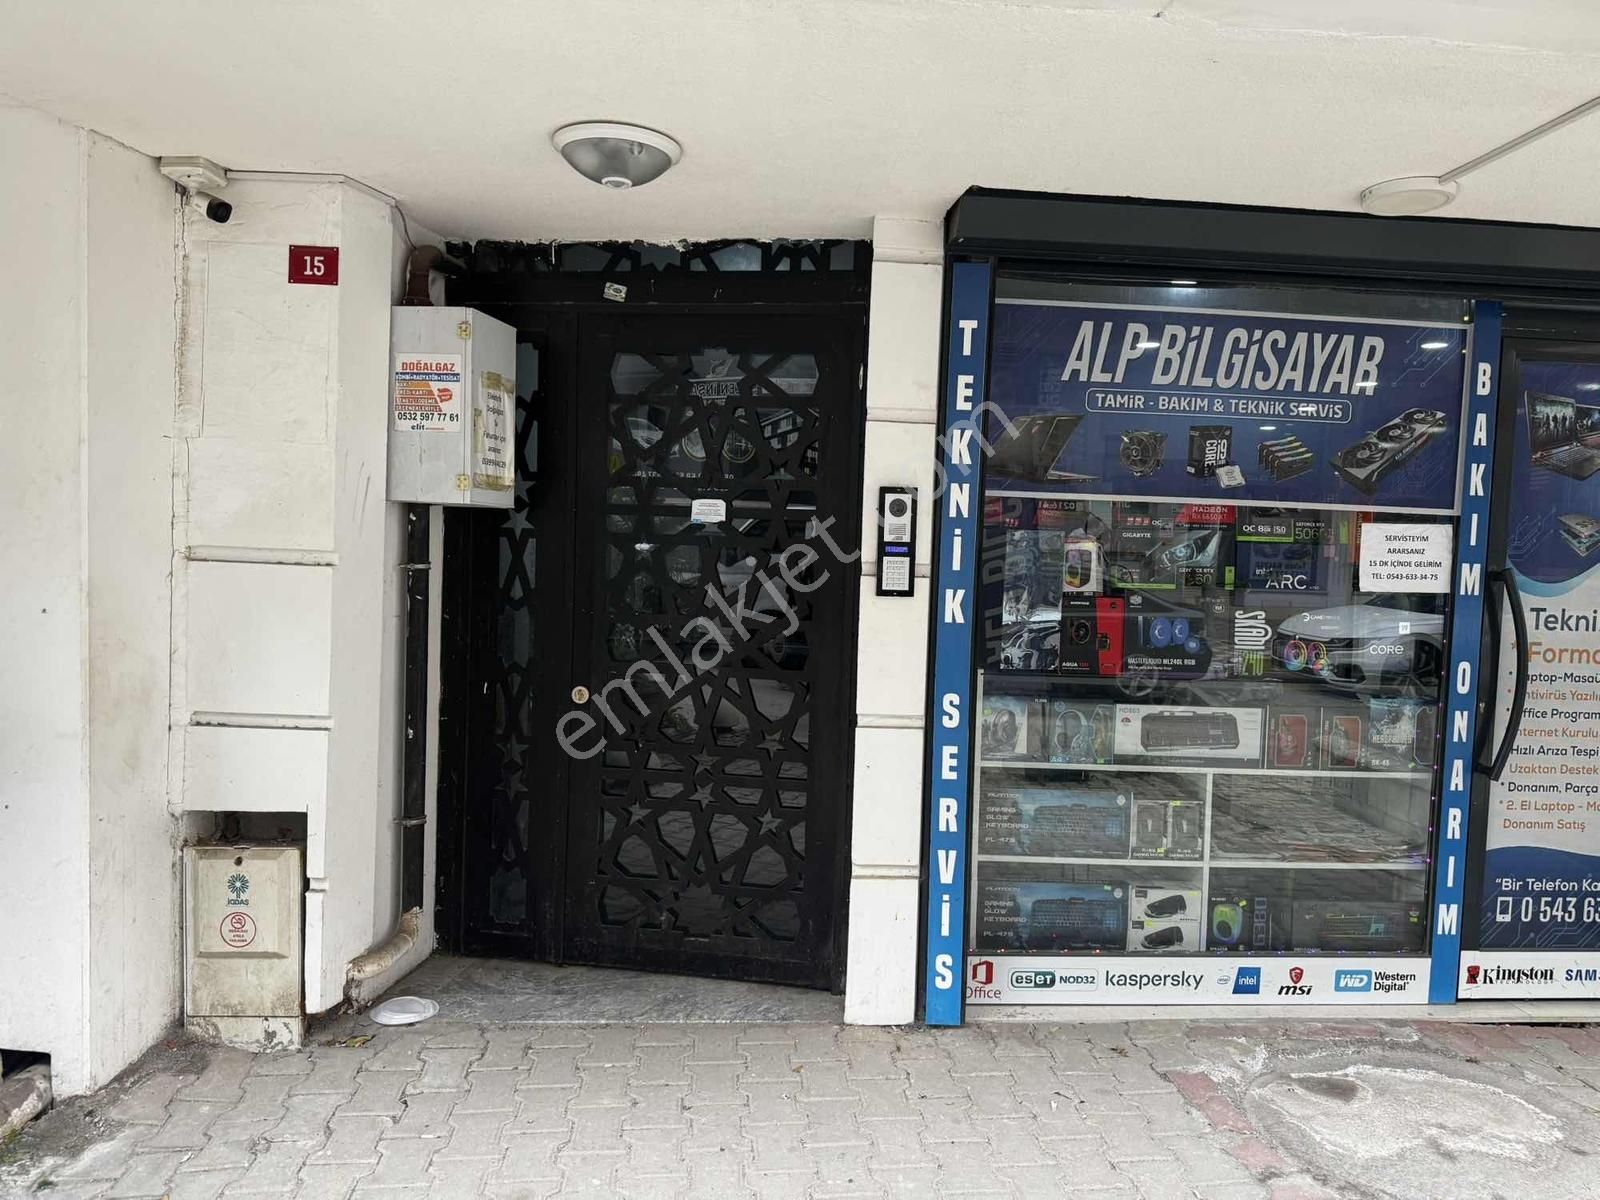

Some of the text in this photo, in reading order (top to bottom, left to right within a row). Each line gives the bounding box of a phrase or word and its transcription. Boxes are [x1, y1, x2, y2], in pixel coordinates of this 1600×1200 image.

[303, 257, 325, 276] 15
[1060, 320, 1149, 384] ALP
[401, 360, 456, 372] DOĞALGAZ
[1159, 396, 1208, 411] BAKIM
[397, 412, 459, 422] 0532 597 77 61
[1204, 439, 1217, 467] CORE
[1460, 362, 1492, 596] BAKIM
[1191, 505, 1228, 513] RADEON
[1242, 524, 1256, 532] OC
[1265, 574, 1307, 590] ARC
[1386, 573, 1438, 581] 0543-633-34-75
[1530, 607, 1600, 632] Tekni
[1525, 689, 1566, 701] ntivirüs
[1521, 708, 1548, 719] ffice
[1517, 727, 1600, 738] nternet Kurulu
[1537, 745, 1568, 756] Arıza
[1509, 763, 1557, 775] Uzaktan
[1507, 781, 1599, 796] Donanım, Parça
[1437, 661, 1471, 936] ONARIM
[1506, 800, 1517, 811] 2.
[1520, 800, 1532, 811] El
[1534, 800, 1575, 813] Laptop
[1502, 818, 1586, 832] Donanım Satış
[1526, 879, 1578, 891] Telefon
[1521, 896, 1533, 922] 0
[1539, 896, 1577, 922] 543
[1059, 975, 1096, 985] NOD32
[1105, 970, 1204, 990] kaspersky
[1238, 976, 1257, 985] intel
[1374, 971, 1416, 982] Western
[1483, 965, 1555, 985] Kingston
[1565, 968, 1600, 983] SAM
[1278, 985, 1313, 996] msi
